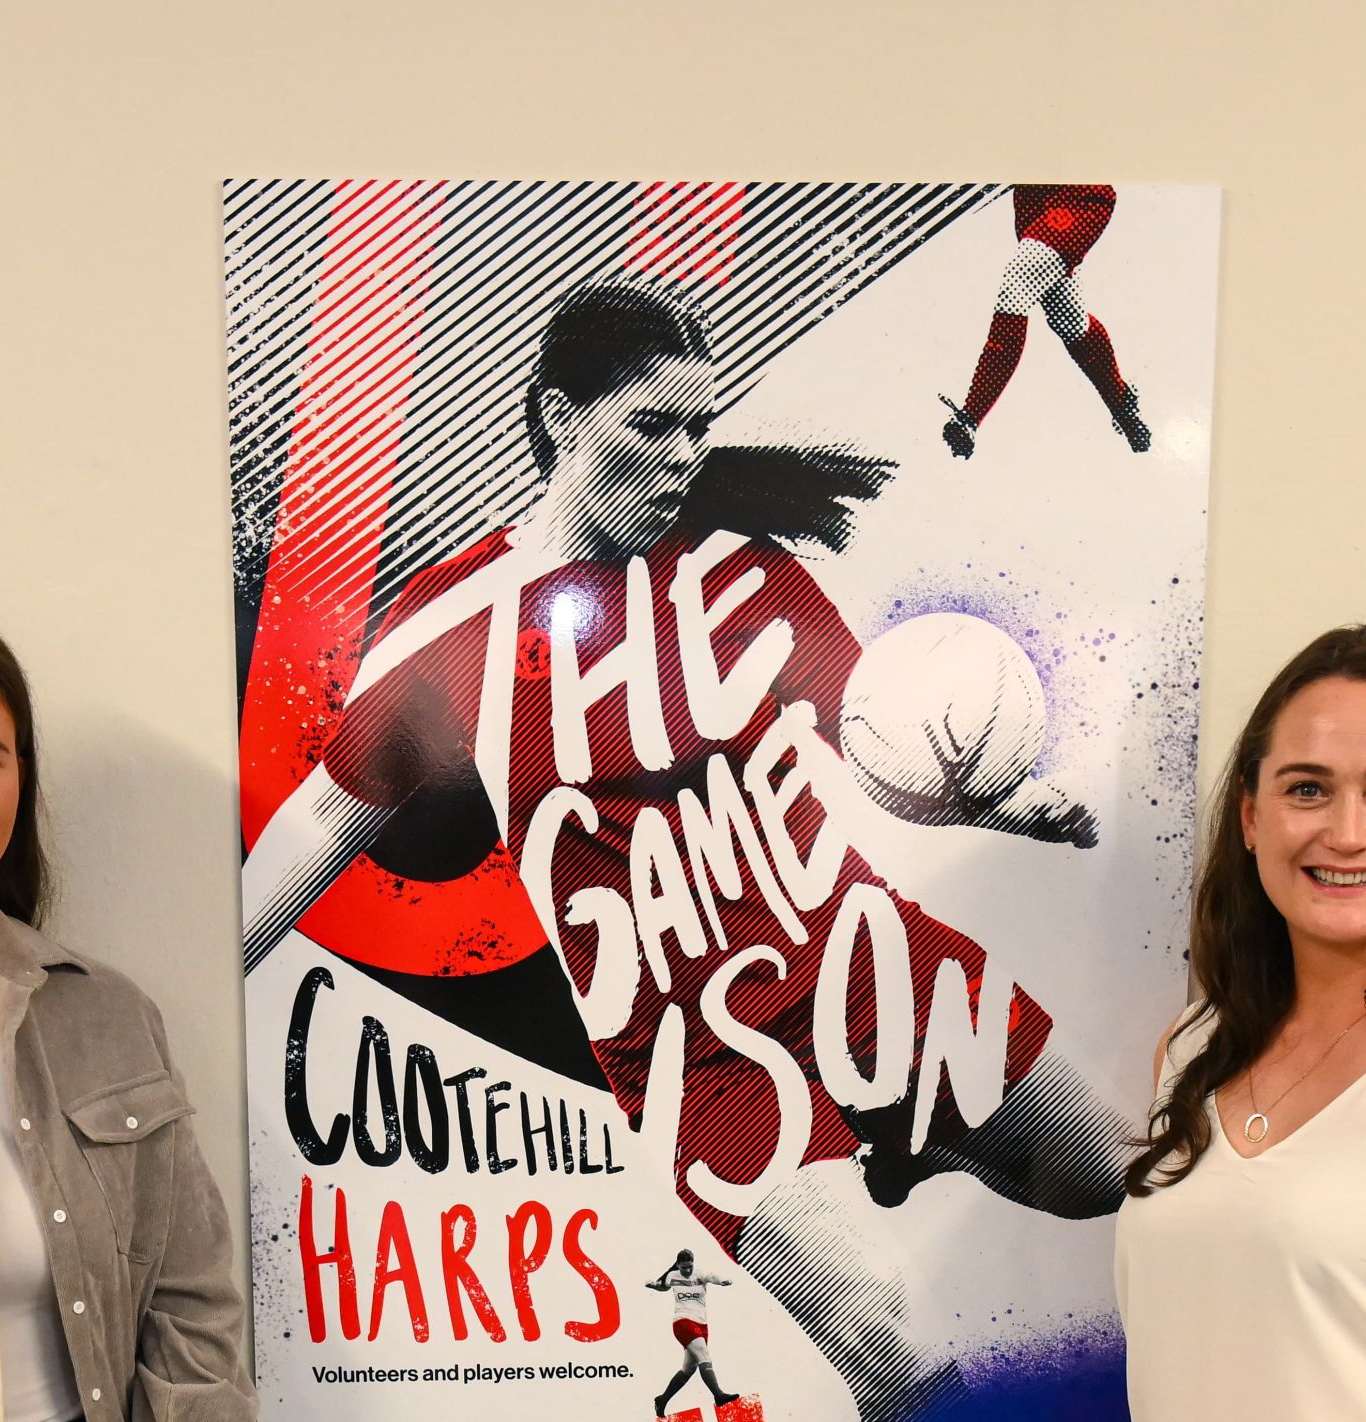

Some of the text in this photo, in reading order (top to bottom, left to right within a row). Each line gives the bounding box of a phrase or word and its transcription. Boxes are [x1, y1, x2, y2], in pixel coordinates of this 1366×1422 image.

[344, 528, 796, 848] THE
[519, 699, 855, 1041] GAME
[284, 966, 625, 1175] COOTEHILL
[638, 884, 1014, 1216] IS ON
[299, 1174, 620, 1342] HARPS
[312, 1361, 634, 1384] Volunteers and players welcome.
